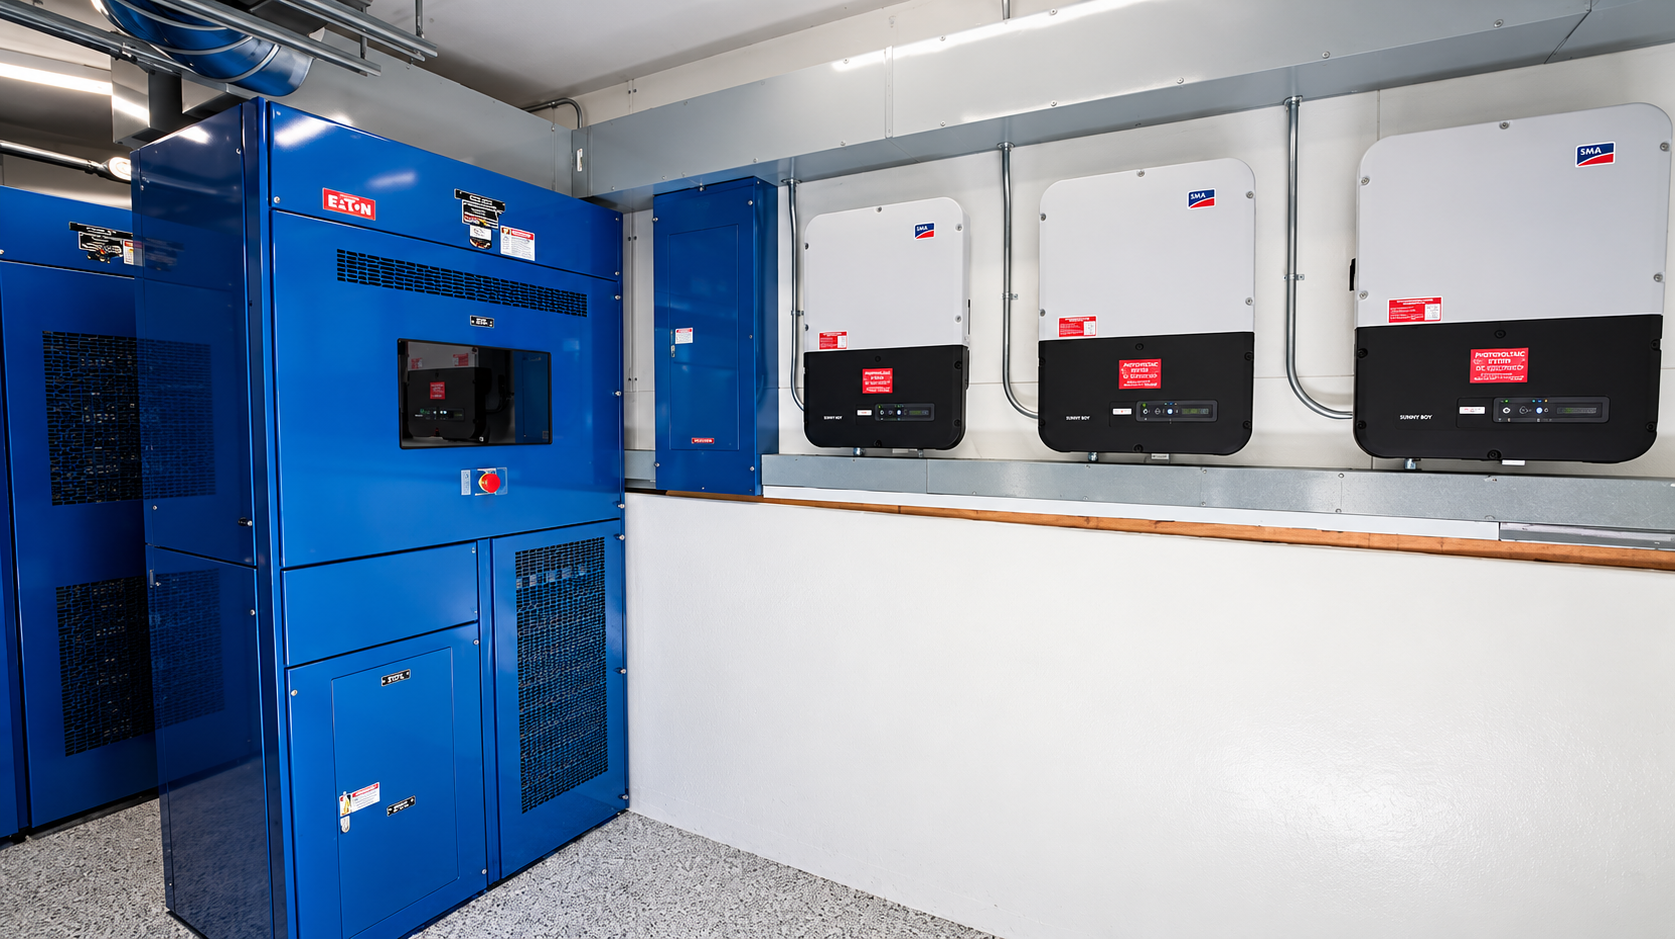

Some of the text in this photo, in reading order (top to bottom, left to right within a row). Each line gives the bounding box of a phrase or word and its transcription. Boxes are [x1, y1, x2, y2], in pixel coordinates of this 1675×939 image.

[1580, 146, 1601, 155] SMA
[1190, 192, 1206, 200] SMA
[328, 194, 371, 216] EATON
